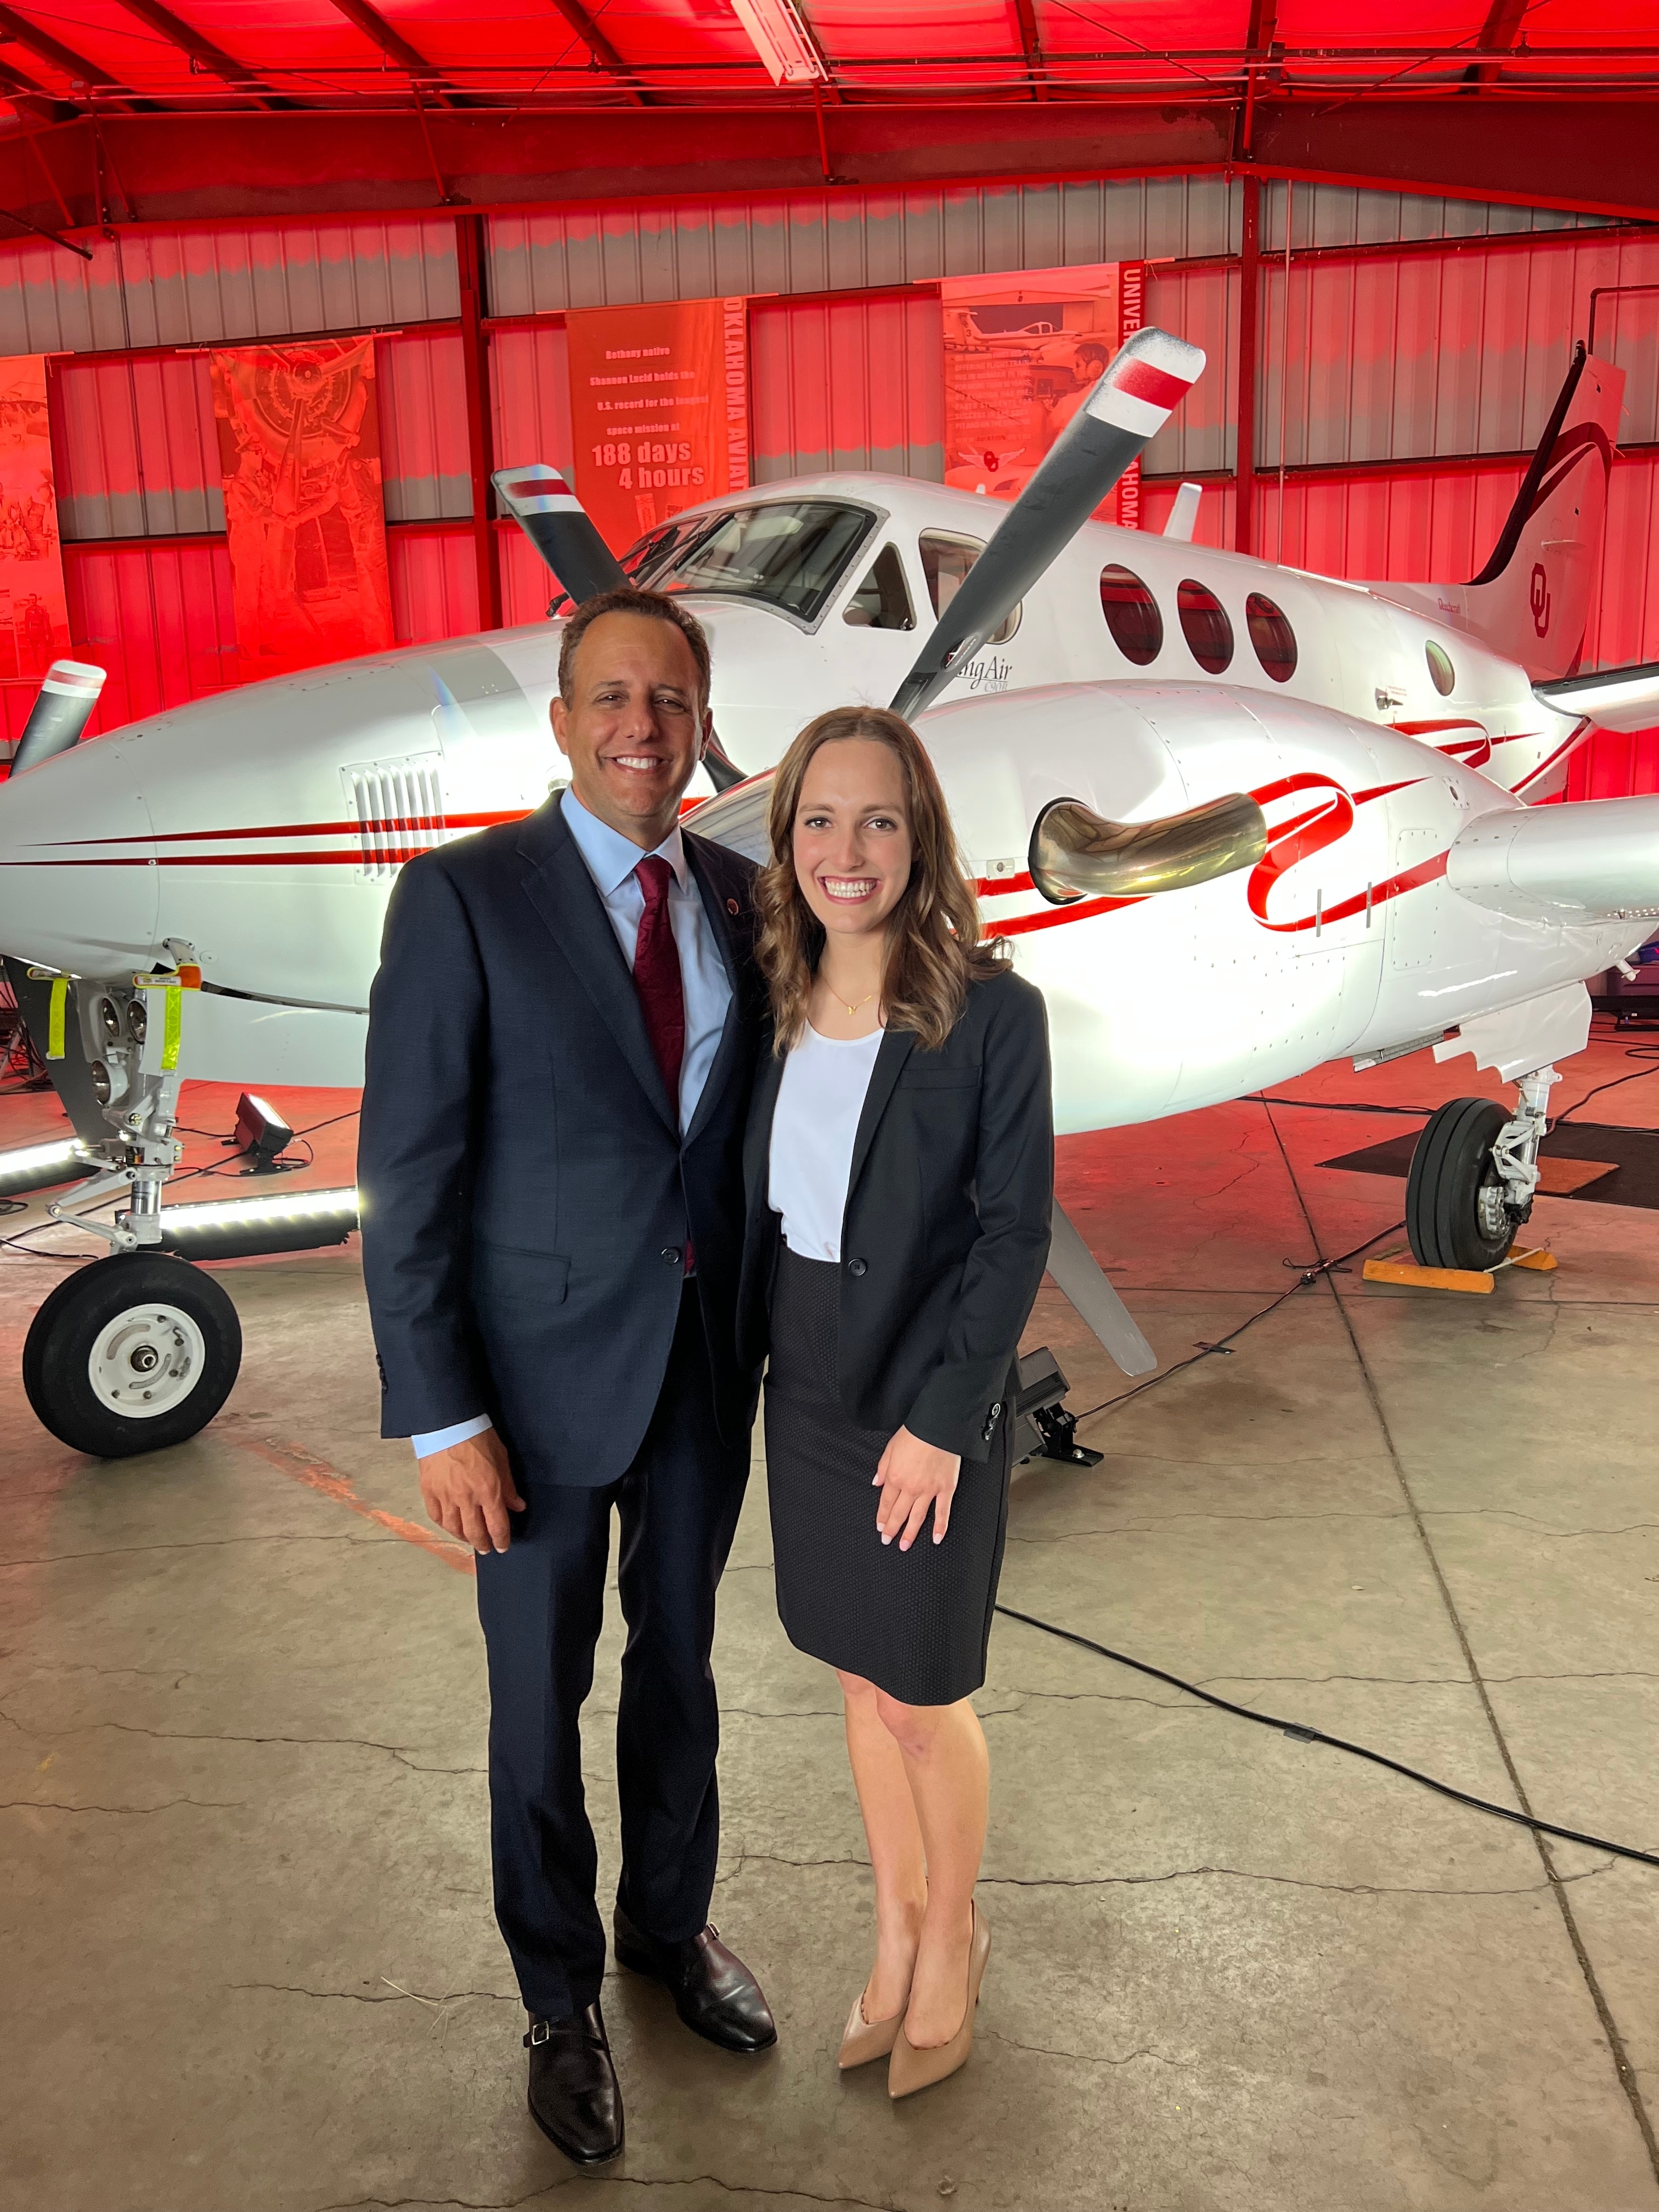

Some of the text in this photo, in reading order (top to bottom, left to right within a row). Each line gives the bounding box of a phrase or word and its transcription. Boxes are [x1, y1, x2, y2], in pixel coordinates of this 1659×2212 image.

[606, 347, 670, 359] Bethany native
[590, 371, 695, 386] Shannon Lucid holds the
[597, 395, 709, 411] U.S. record for the longest
[724, 297, 747, 493] OKLAHOMA AVIAT
[606, 422, 680, 436] space mission at
[591, 441, 691, 466] 188 days
[619, 466, 704, 489] 4 hours
[1530, 562, 1551, 639] OU
